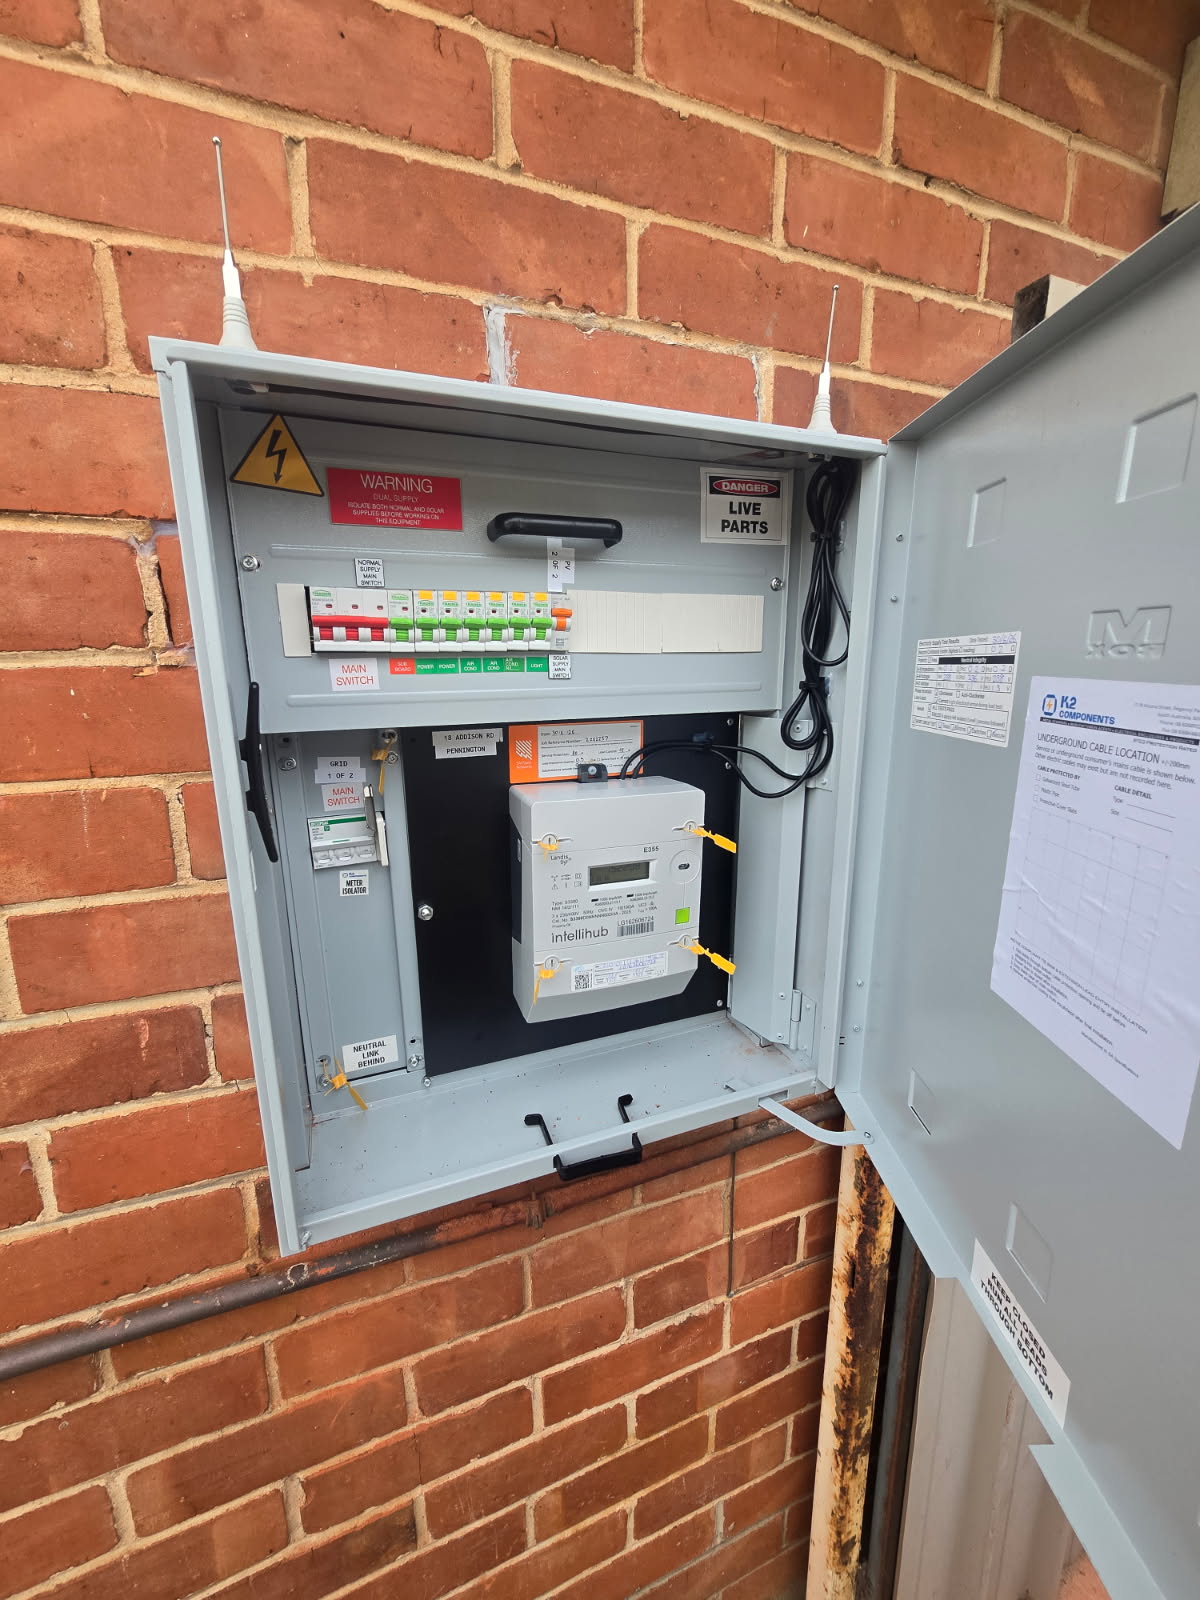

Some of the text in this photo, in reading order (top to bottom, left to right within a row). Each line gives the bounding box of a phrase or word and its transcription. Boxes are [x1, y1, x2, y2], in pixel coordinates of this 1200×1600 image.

[360, 474, 432, 493] WARNING
[722, 482, 768, 493] DANGER
[729, 501, 762, 515] LIVE
[721, 519, 768, 534] PARTS
[553, 560, 558, 570] OF
[565, 560, 571, 570] PV
[341, 664, 367, 673] MAIN
[336, 676, 374, 686] SWITCH
[1060, 696, 1077, 709] K2
[1059, 711, 1115, 725] COMPONENTS
[1037, 733, 1087, 749] UNDERGROUND
[1090, 742, 1114, 755] CABLE
[1115, 746, 1160, 764] LOCATION
[1130, 765, 1145, 774] cable
[1153, 770, 1173, 779] shown
[1175, 774, 1196, 784] below.
[1130, 774, 1155, 786] recorded
[332, 787, 354, 795] MAIN
[1114, 785, 1152, 800] CABLE DETAIL
[327, 796, 360, 806] SWITCH
[342, 887, 366, 895] ISOLATOR
[551, 927, 608, 943] intellihub
[353, 1040, 387, 1052] NEUTRAL
[362, 1050, 380, 1059] LINK
[358, 1057, 385, 1068] BEHIND
[991, 1271, 1046, 1359] KEEP CLOSED
[987, 1278, 1048, 1377] RUN ALL LEADS
[980, 1280, 1054, 1401] THROUGH BOTTOM
